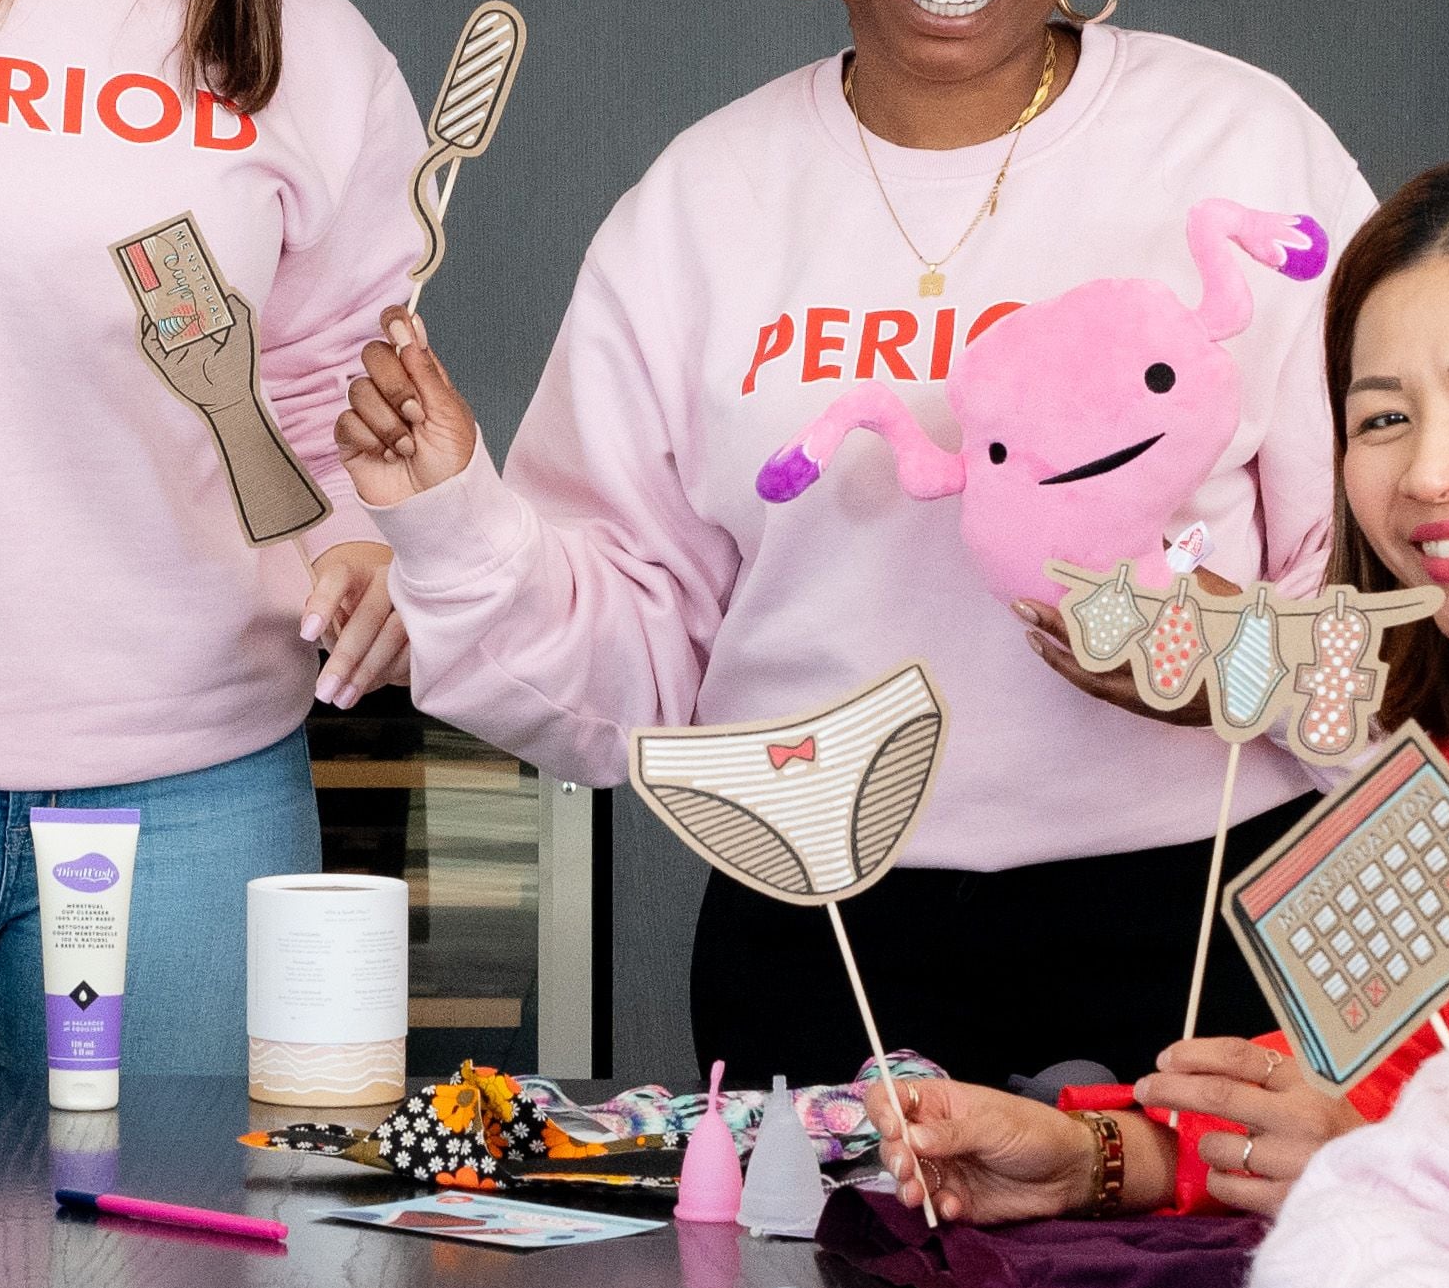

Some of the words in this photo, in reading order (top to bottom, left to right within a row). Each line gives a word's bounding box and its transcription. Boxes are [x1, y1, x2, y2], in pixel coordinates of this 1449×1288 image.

[173, 230, 221, 326] MENSTRUAL
[739, 299, 1032, 399] PERI
[56, 866, 115, 884] DivaWash
